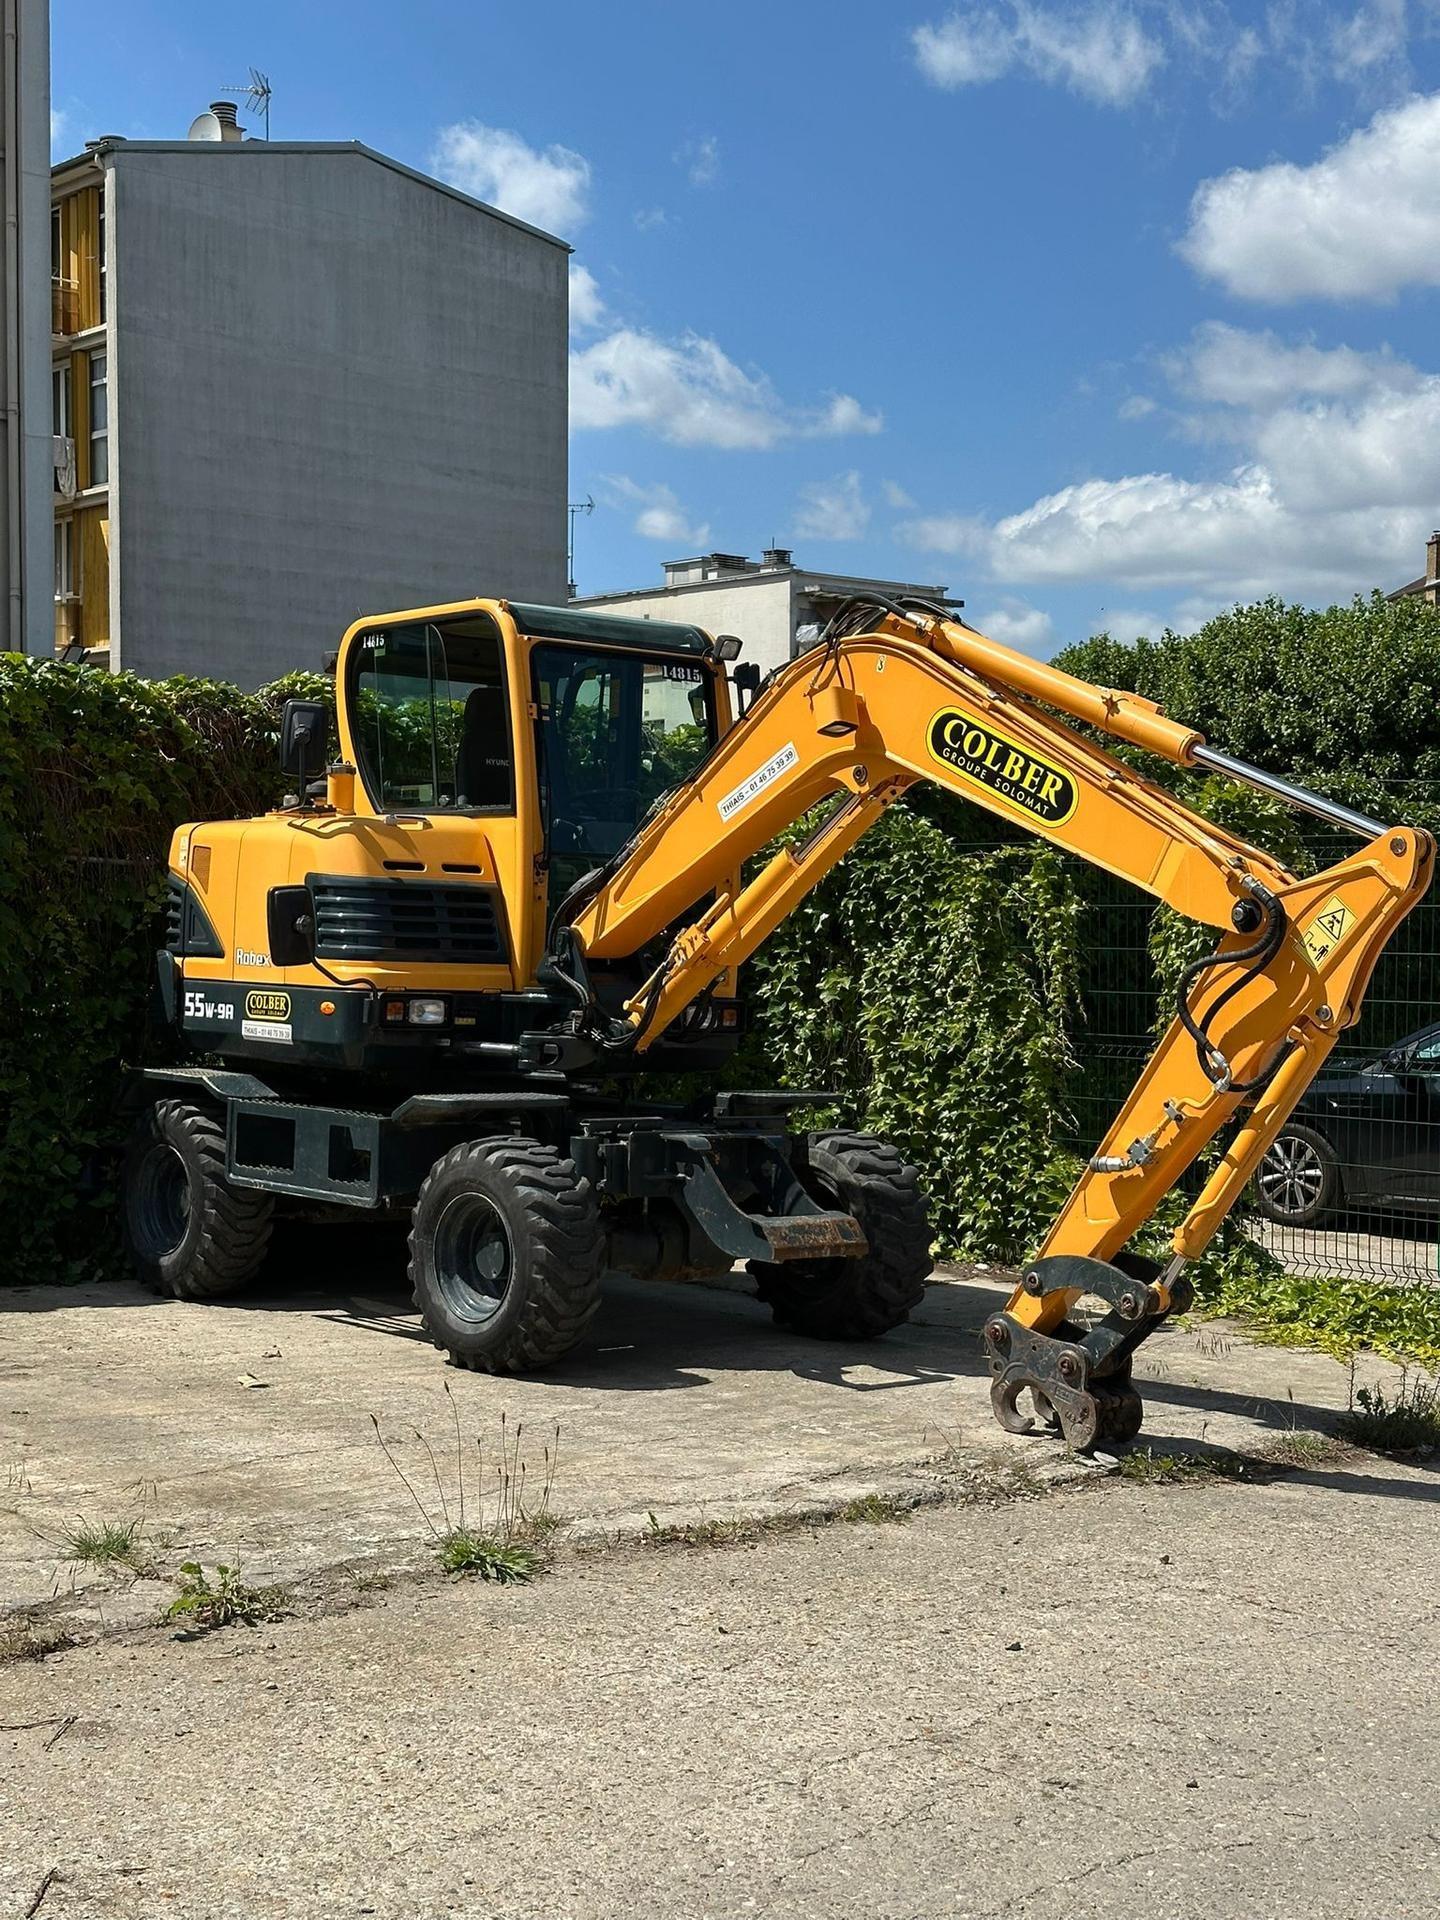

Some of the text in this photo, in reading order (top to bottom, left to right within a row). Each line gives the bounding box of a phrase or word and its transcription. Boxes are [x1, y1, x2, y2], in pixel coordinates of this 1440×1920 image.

[663, 665, 700, 681] 14815
[722, 792, 745, 813] THIAIS
[749, 781, 758, 791] 01
[759, 773, 767, 783] 46
[767, 766, 776, 776] 75
[776, 759, 784, 769] 39
[785, 750, 793, 761] 39
[942, 747, 1050, 815] GROUPE SOLOMAT
[943, 719, 1063, 808] COLBER
[250, 995, 286, 1011] COLBER
